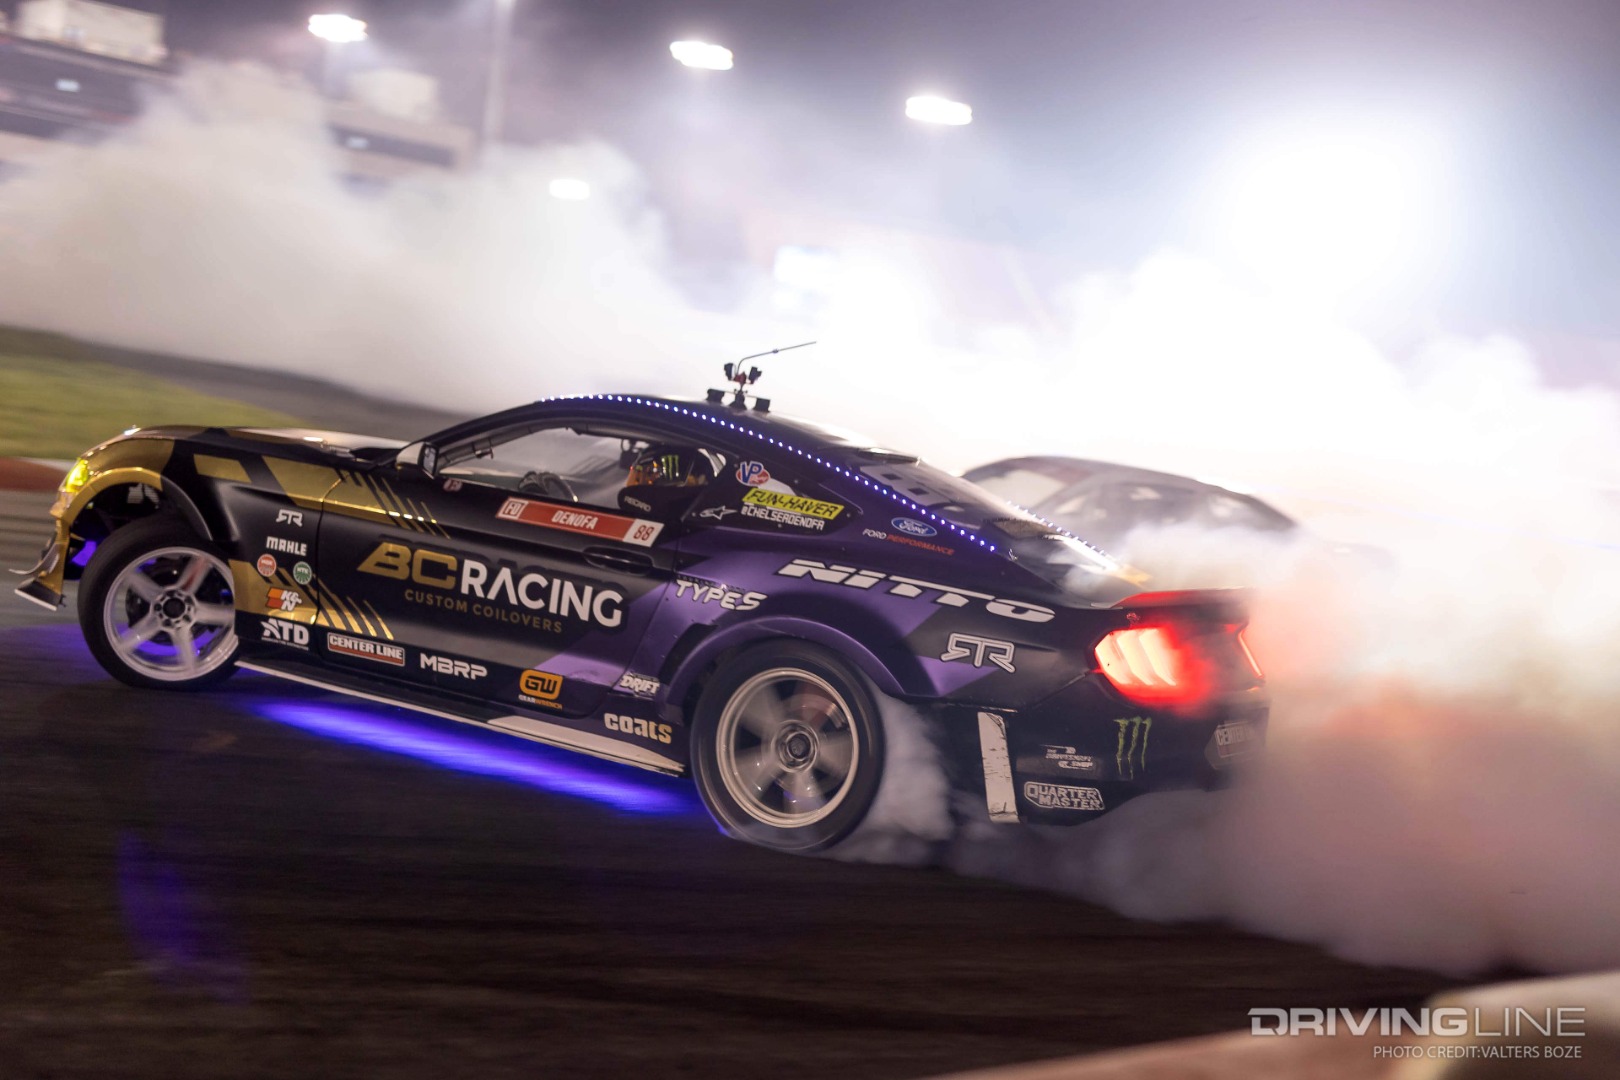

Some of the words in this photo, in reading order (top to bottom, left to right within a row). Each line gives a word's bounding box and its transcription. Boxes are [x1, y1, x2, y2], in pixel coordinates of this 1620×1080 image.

[740, 461, 764, 484] VP
[551, 510, 598, 530] DENOFA
[899, 519, 928, 535] Ford
[633, 524, 655, 541] 88
[862, 528, 887, 539] FORD
[266, 536, 307, 557] MAHLE
[777, 558, 1056, 623] NITTO
[404, 588, 469, 614] CUSTOM
[472, 603, 563, 634] COILOVERS
[329, 635, 375, 655] CENTER
[376, 644, 404, 660] LINE
[420, 653, 488, 680] MBRP
[1027, 784, 1097, 800] QUARTER
[1039, 795, 1101, 810] MASTER
